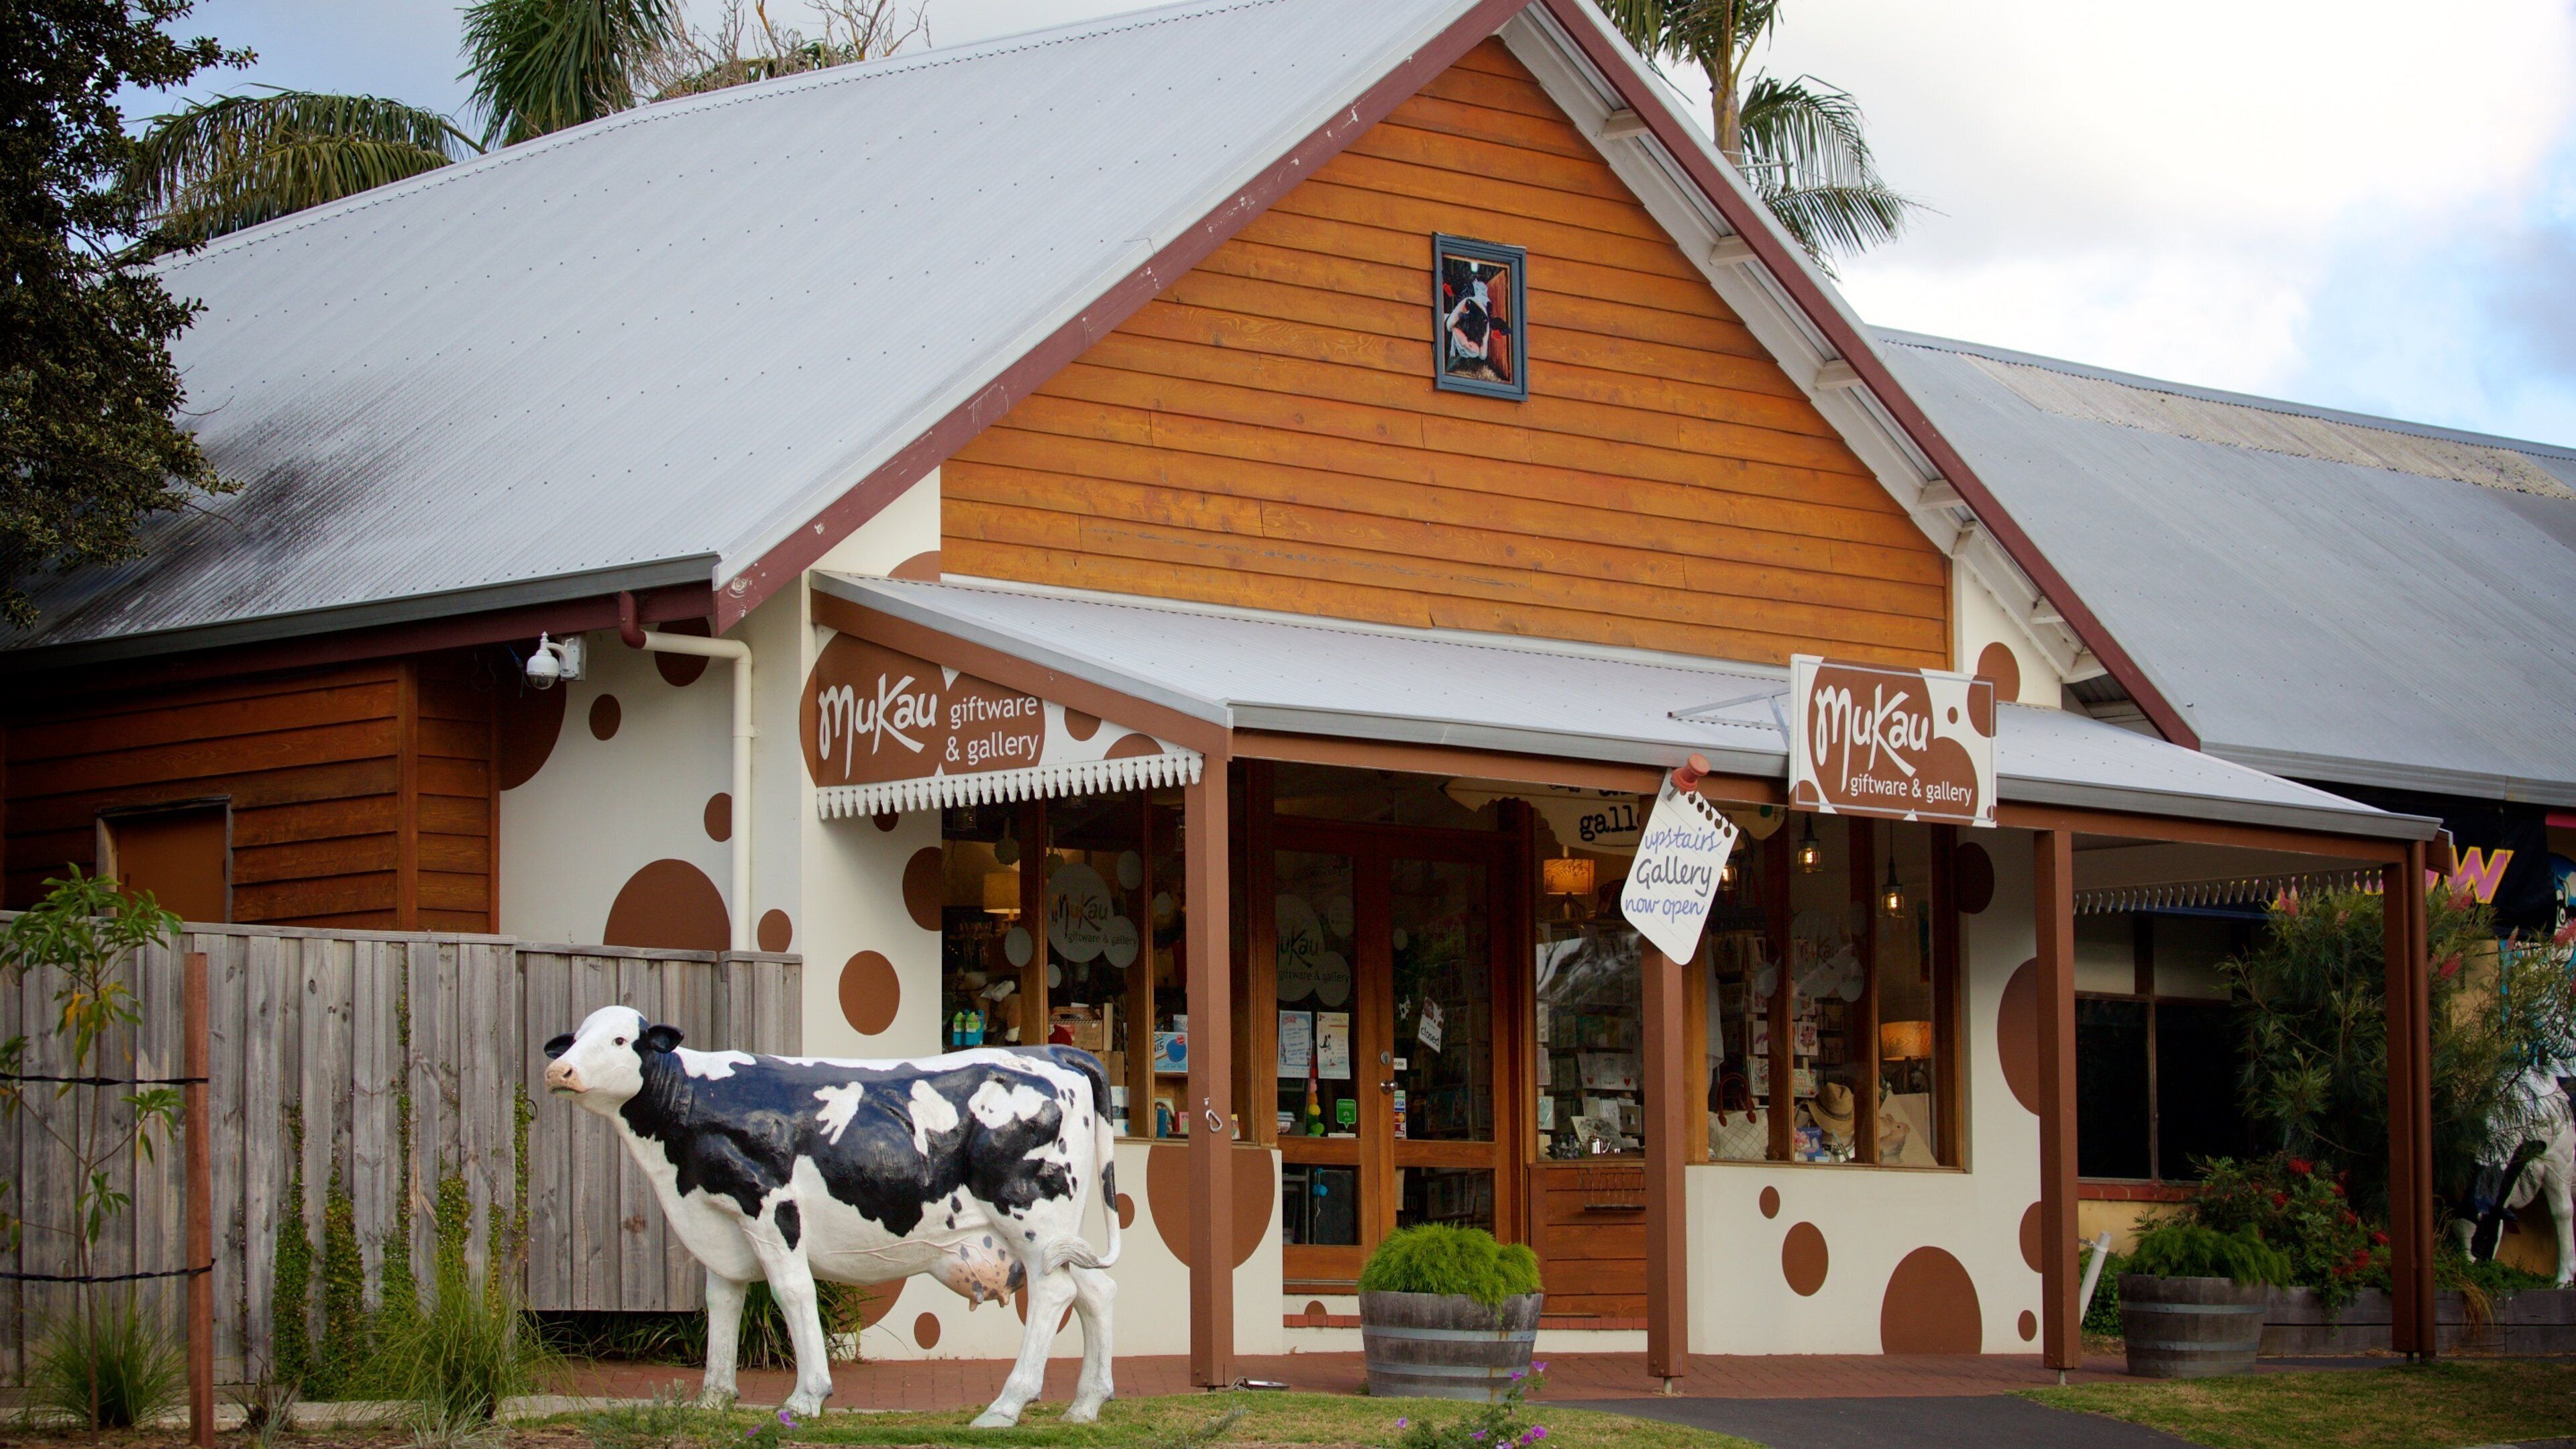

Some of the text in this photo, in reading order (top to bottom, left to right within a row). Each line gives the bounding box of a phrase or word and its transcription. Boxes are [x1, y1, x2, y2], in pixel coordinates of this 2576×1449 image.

[950, 695, 1038, 730] giftware
[946, 731, 1038, 765] & gallery
[1850, 773, 1972, 806] giftware & gallery
[1579, 805, 1640, 841] gall
[1645, 825, 1722, 855] upstairs
[1636, 855, 1711, 898] Gallery
[1625, 898, 1705, 924] now open
[1068, 931, 1100, 943] giftware
[1111, 935, 1138, 947] gallery
[1278, 968, 1350, 984] giftware & gallery
[1421, 1026, 1440, 1047] closed
